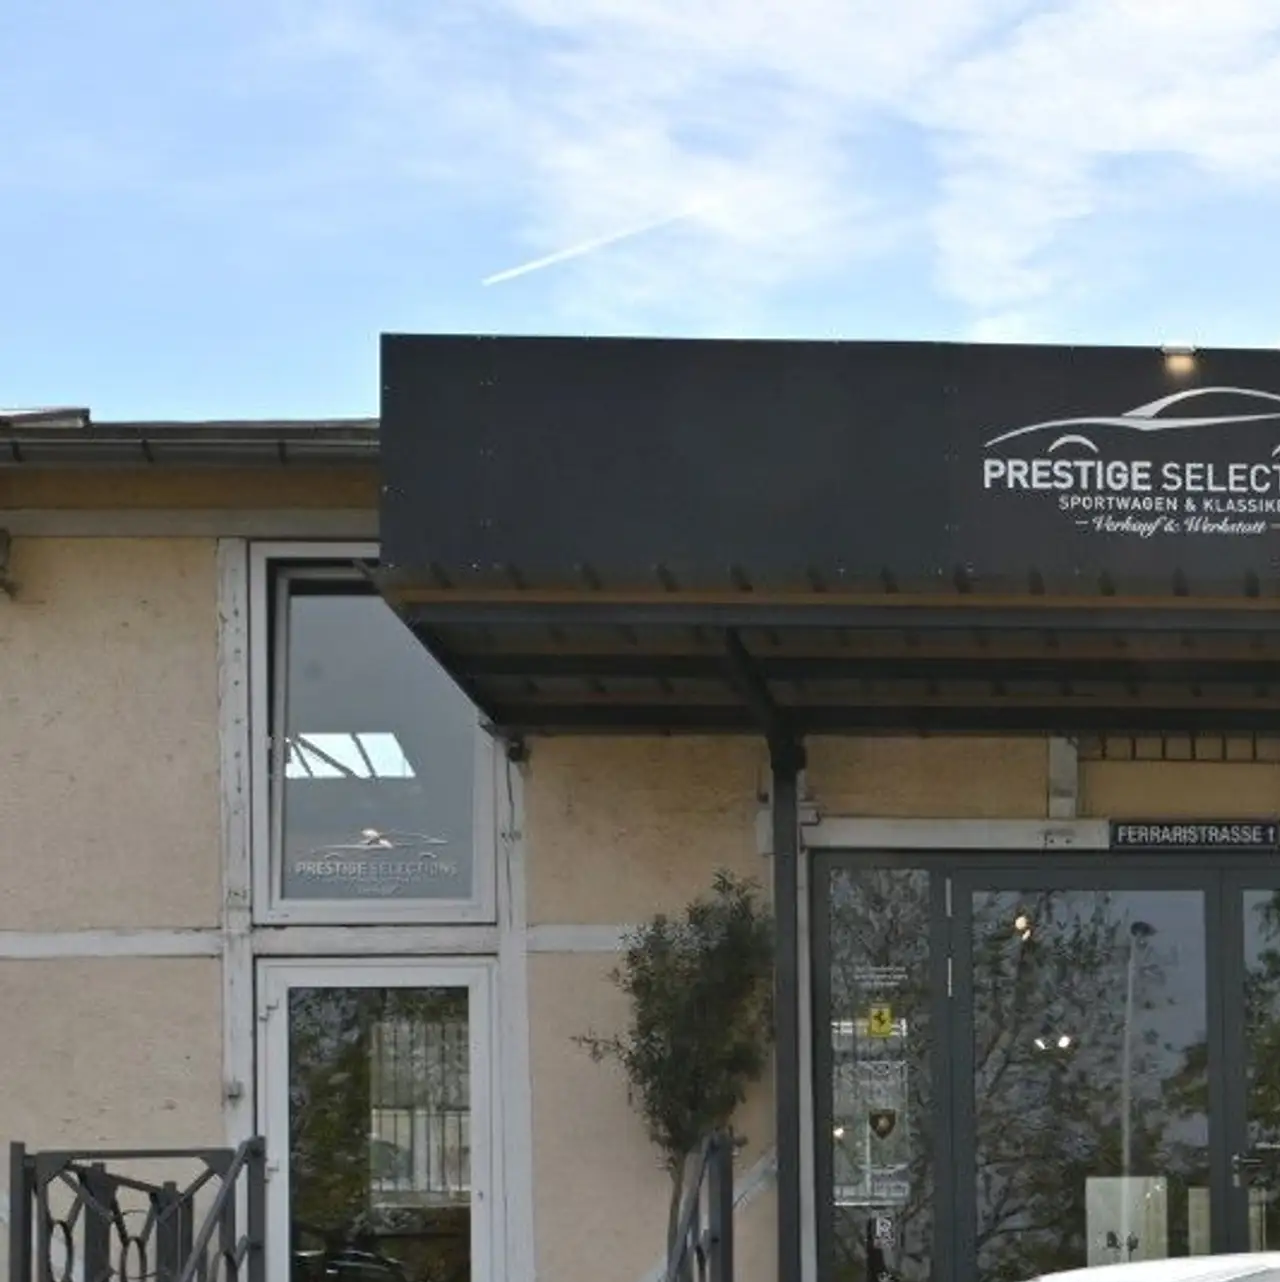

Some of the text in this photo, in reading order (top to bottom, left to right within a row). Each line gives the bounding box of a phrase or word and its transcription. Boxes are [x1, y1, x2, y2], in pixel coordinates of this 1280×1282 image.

[983, 458, 1152, 490] PRESTIGE
[1058, 495, 1178, 511] SPORTWAGEN
[1184, 498, 1196, 512] &
[1117, 825, 1276, 843] FERRARISTRASSE 1
